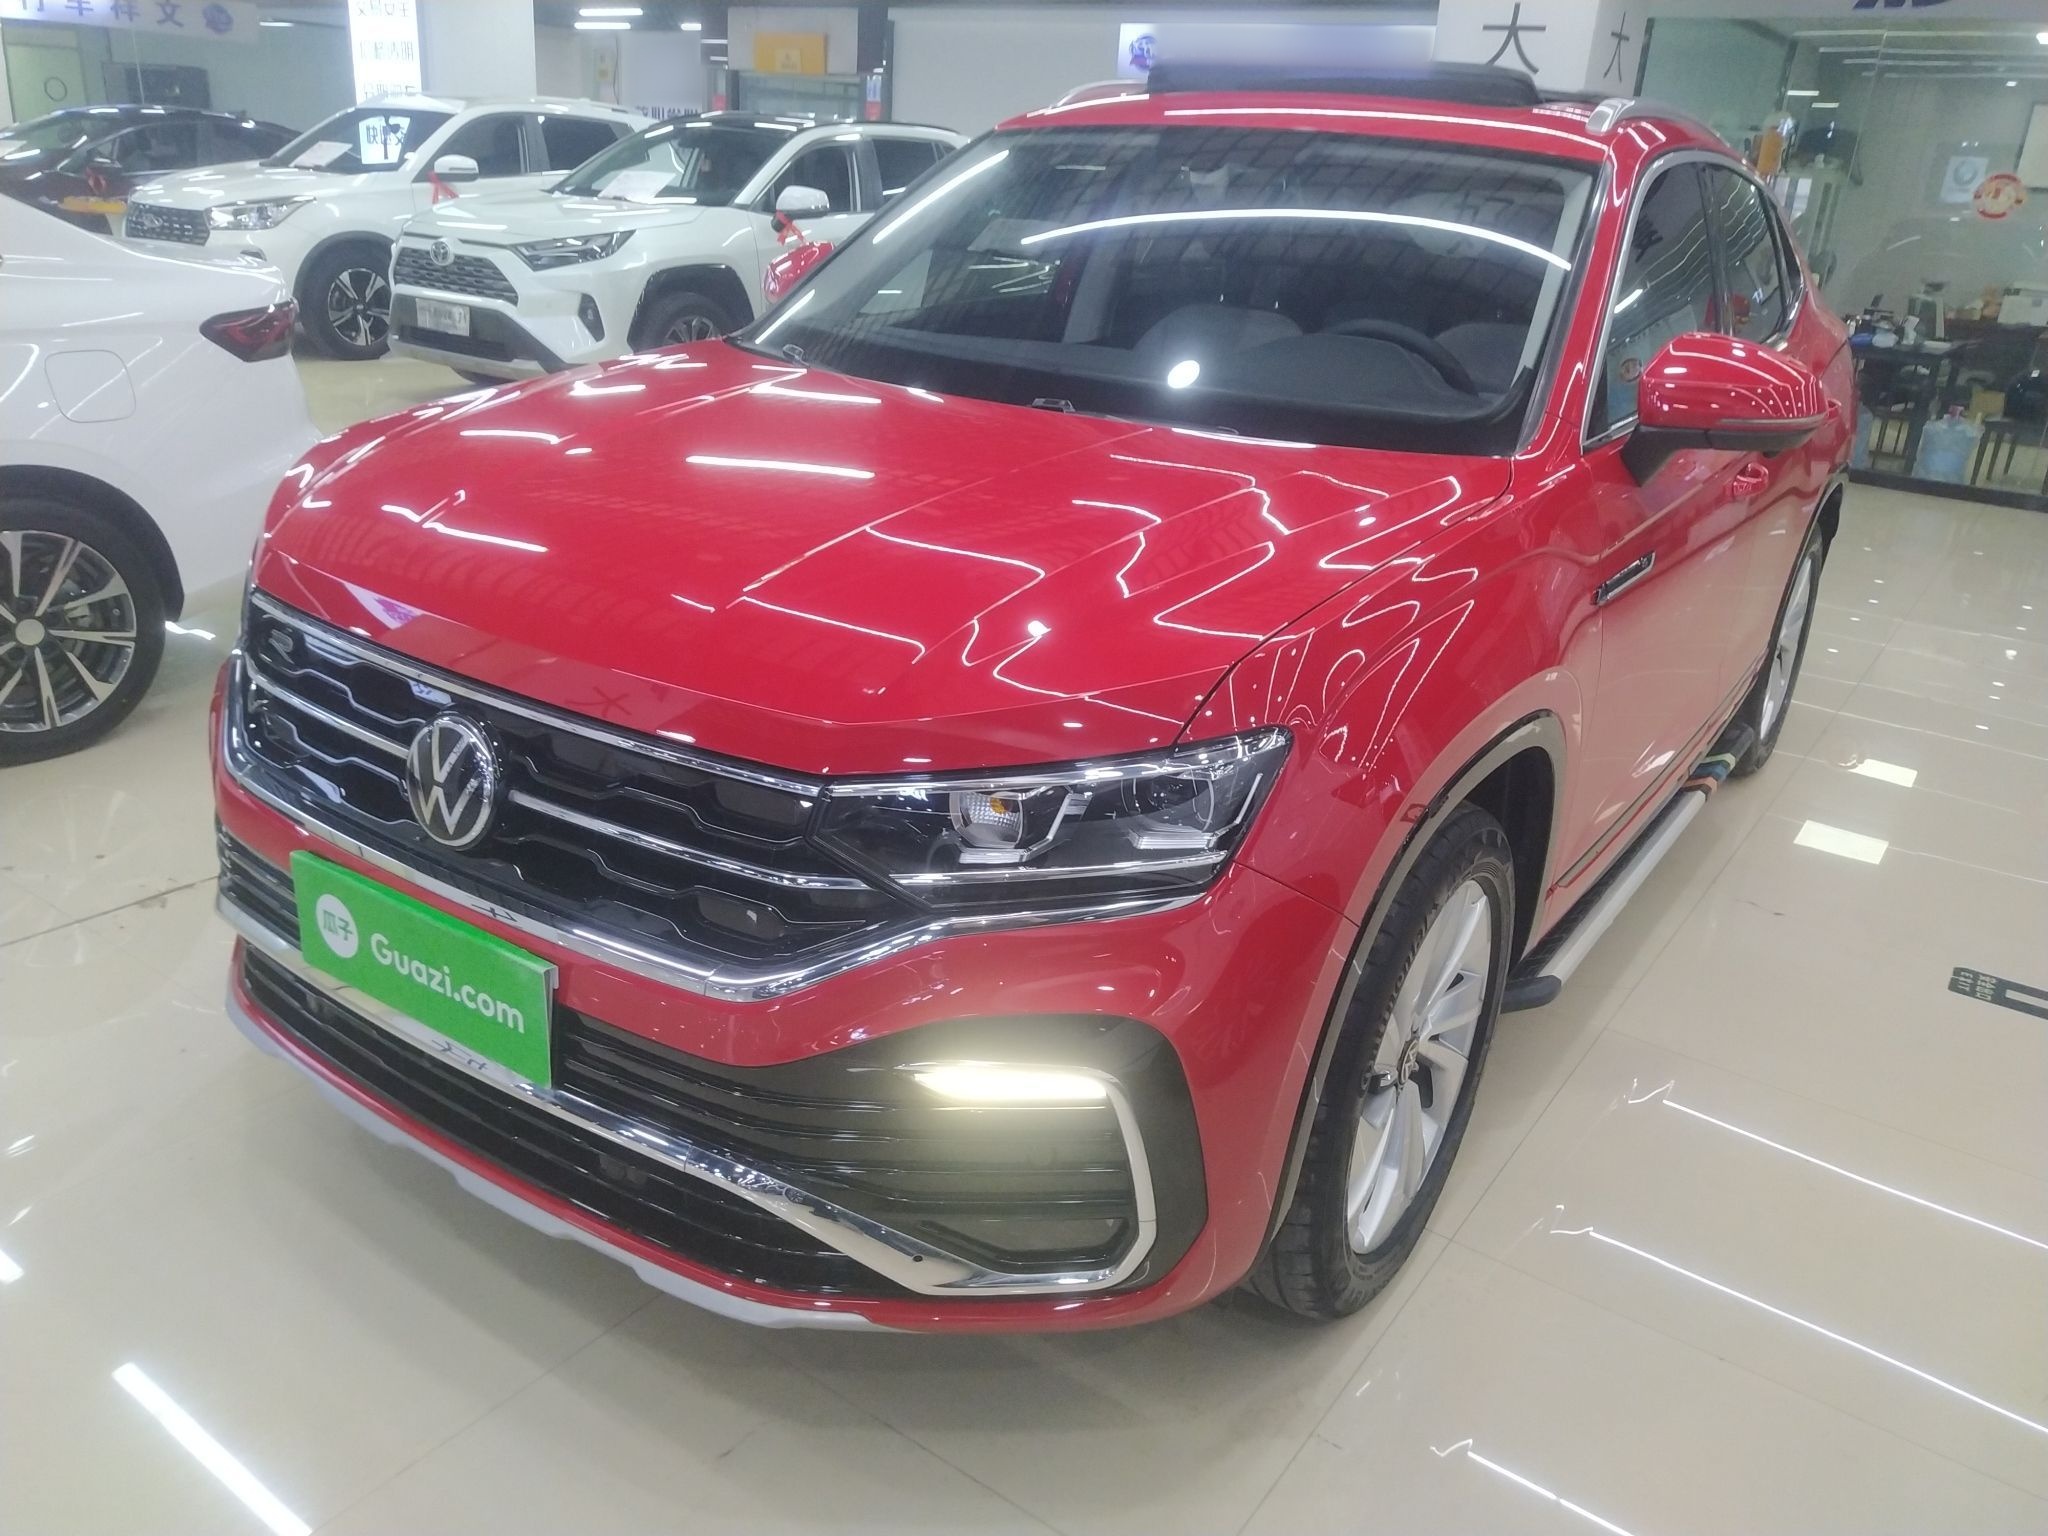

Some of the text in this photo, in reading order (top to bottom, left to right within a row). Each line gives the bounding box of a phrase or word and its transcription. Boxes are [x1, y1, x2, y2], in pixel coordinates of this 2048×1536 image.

[1483, 2, 1546, 74] 大
[1603, 12, 1630, 83] 大
[322, 909, 353, 942] 瓜子
[370, 932, 525, 1034] Guazi.com
